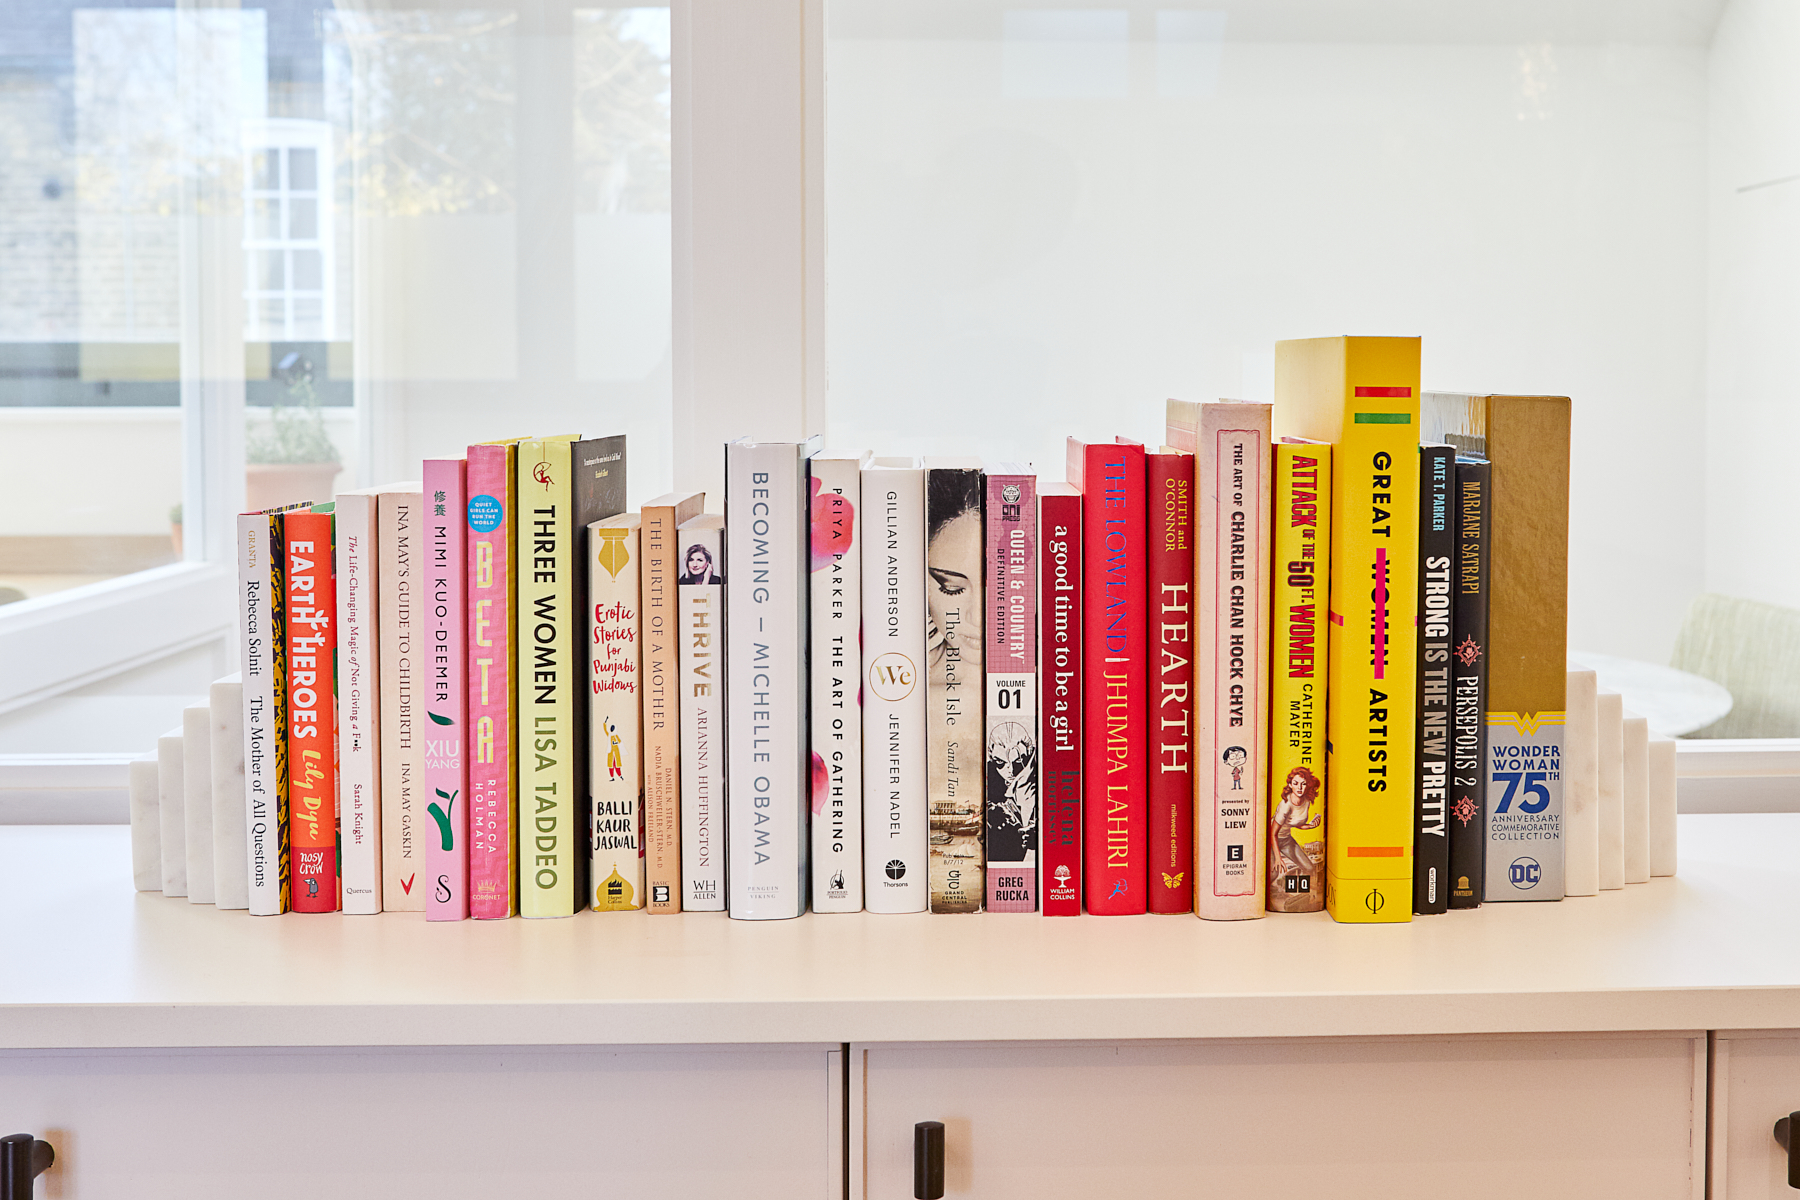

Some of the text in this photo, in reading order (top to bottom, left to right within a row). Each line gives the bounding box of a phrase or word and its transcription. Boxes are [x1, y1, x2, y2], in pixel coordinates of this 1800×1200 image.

[1165, 478, 1176, 552] O'CONNOR
[1178, 480, 1187, 550] SMITH and
[1433, 457, 1446, 530] KATE T. PARKER
[248, 530, 256, 568] GRANTA
[832, 488, 843, 619] PRIYA PARKER
[887, 491, 898, 637] GILLIAN ANDERSON
[1105, 456, 1127, 652] THE LOWLAND
[1288, 455, 1318, 678] ATTACK OF THE 50 FT. WOMEN
[1462, 481, 1480, 594] MARJANE SATRAPI
[435, 527, 448, 702] MIMI KUO-DEEMER
[534, 505, 557, 704] THREE WOMEN
[595, 602, 635, 623] Erotic
[650, 518, 664, 730] THE BIRTH OF A MOTHER
[996, 548, 1005, 643] DEFINITIVE EDITION
[1010, 530, 1025, 659] QUEEN & COUNTRY
[1230, 443, 1245, 728] THE ART OF CHARLIE CHAN HOCK CHYE
[1368, 451, 1391, 793] GREAT ARTISTS
[247, 581, 262, 676] Rebecca Solnit
[290, 541, 322, 739] EARTH HEROES
[347, 536, 362, 720] The Life-Changing Magic of Not Giving
[398, 505, 411, 749] INA MAY'S GUIDE TO CHILDBIRTH
[476, 541, 493, 763] BETA
[594, 626, 637, 643] Stories
[693, 593, 711, 698] THRIVE
[946, 608, 962, 726] The Black Isle
[1049, 525, 1074, 752] a good time to be a girl
[593, 659, 636, 678] Punjabi
[593, 678, 638, 694] Widows
[753, 472, 770, 866] BECOMING MICHELLE OBAMA
[876, 666, 911, 685] We
[998, 690, 1021, 710] 01
[1161, 582, 1189, 774] HEARTH
[1422, 556, 1450, 837] STRONG IS THE NEW PRETTY
[426, 739, 460, 757] XIU
[426, 759, 460, 769] YANG
[832, 636, 844, 853] THE ART OF GATHERING
[1290, 701, 1300, 748] MAYER
[1302, 684, 1313, 764] CATHERINE
[1454, 675, 1479, 786] PERSEPOLIS 2
[1493, 746, 1560, 757] WONDER
[250, 695, 267, 887] The Mother of All Questions
[293, 750, 325, 840] Lily Dyu
[535, 717, 558, 890] LISA TADDEO
[697, 707, 710, 867] ARIANNA HUFFINGTON
[889, 714, 900, 839] JENNIFER NADEL
[947, 741, 959, 797] Sandi Tan
[1103, 670, 1128, 868] JHUMPA LAHIRI
[1493, 759, 1561, 770] WOMAN
[353, 784, 364, 844] Sarah Knight
[402, 763, 412, 859] INA MAY GASKIN
[475, 783, 484, 849] HOLMAN
[488, 780, 497, 853] REBECCA
[594, 836, 638, 850] JASWAL
[597, 801, 632, 815] BALLI
[597, 819, 632, 833] KAUR
[1044, 771, 1059, 846] morrissey
[1061, 771, 1080, 846] helena
[1221, 808, 1250, 816] SONNY
[1225, 820, 1247, 829] LIEW
[299, 862, 323, 874] crow
[346, 887, 372, 895] Quercus
[693, 880, 716, 890] WH
[996, 891, 1029, 901] RUCKA
[998, 877, 1024, 887] GREG
[1510, 865, 1540, 883] DC
